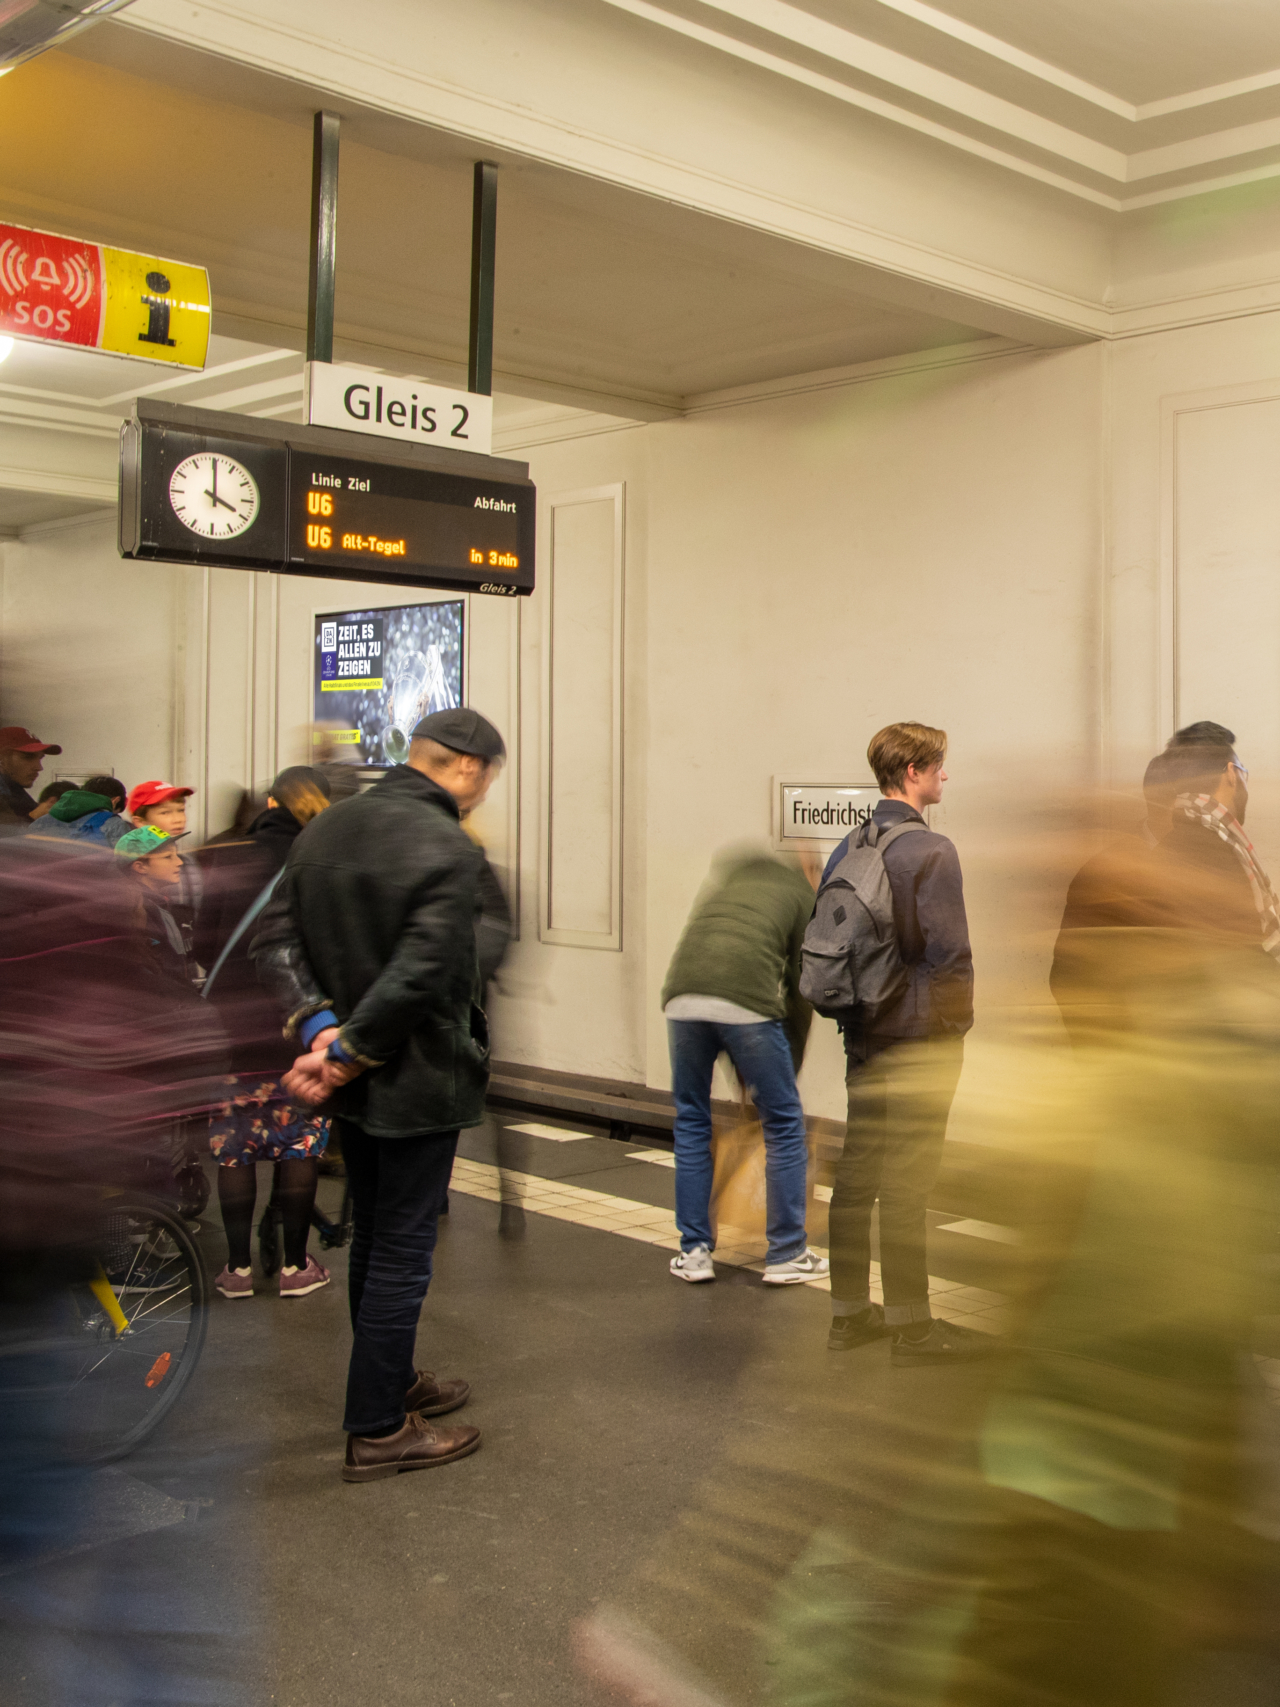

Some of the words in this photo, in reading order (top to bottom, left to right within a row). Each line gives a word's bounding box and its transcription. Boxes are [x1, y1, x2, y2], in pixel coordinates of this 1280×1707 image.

[13, 301, 71, 332] SOS
[343, 384, 437, 433] Gleis
[450, 404, 469, 439] 2
[308, 491, 333, 516] U6
[312, 472, 342, 488] Linie
[348, 477, 370, 492] Ziel
[474, 496, 516, 514] Abfahrt
[307, 524, 332, 549] U6
[342, 533, 405, 556] Alt-Tegel
[470, 548, 484, 564] in
[479, 583, 507, 594] Gleis
[508, 586, 517, 595] 2
[338, 625, 360, 641] ZEIT,
[361, 623, 374, 639] ES
[338, 642, 366, 658] ALLEN
[368, 641, 381, 657] ZU
[338, 660, 371, 676] ZEIGEN
